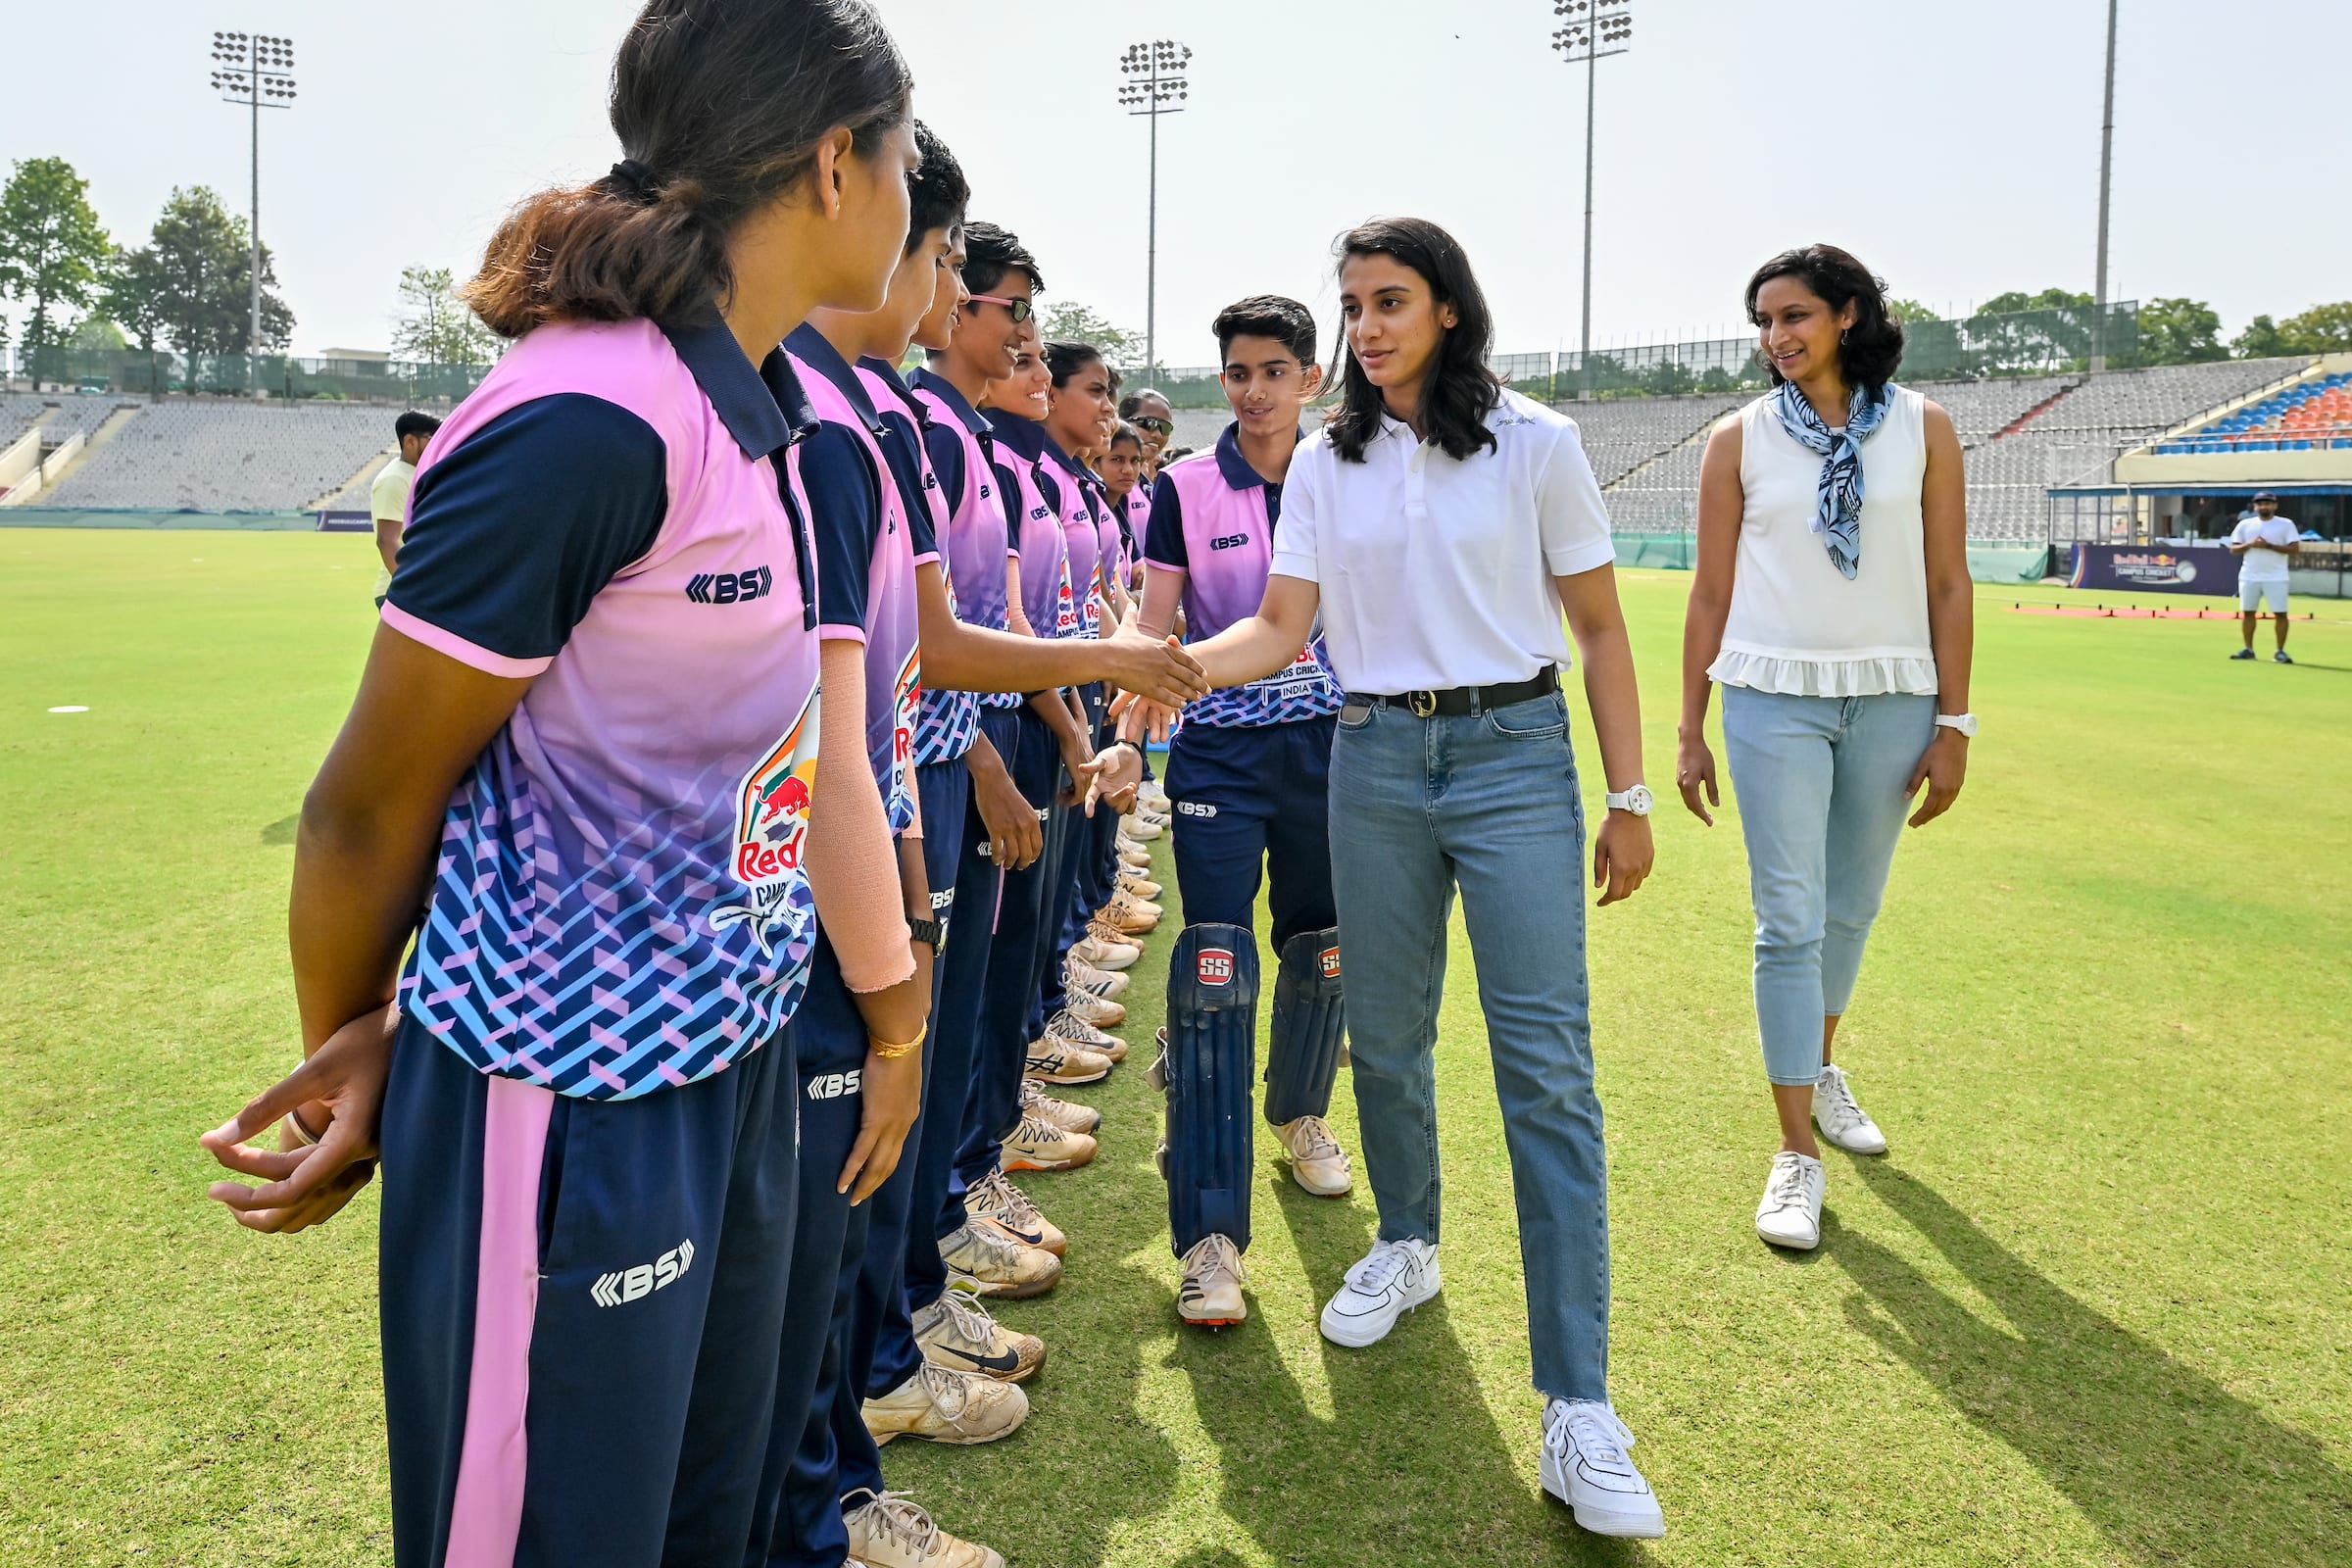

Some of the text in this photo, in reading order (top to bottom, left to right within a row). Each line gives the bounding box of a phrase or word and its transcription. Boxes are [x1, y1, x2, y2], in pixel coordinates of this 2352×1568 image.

[1283, 684, 1309, 697] INDIA
[737, 826, 805, 882] Red
[1200, 956, 1230, 977] SS
